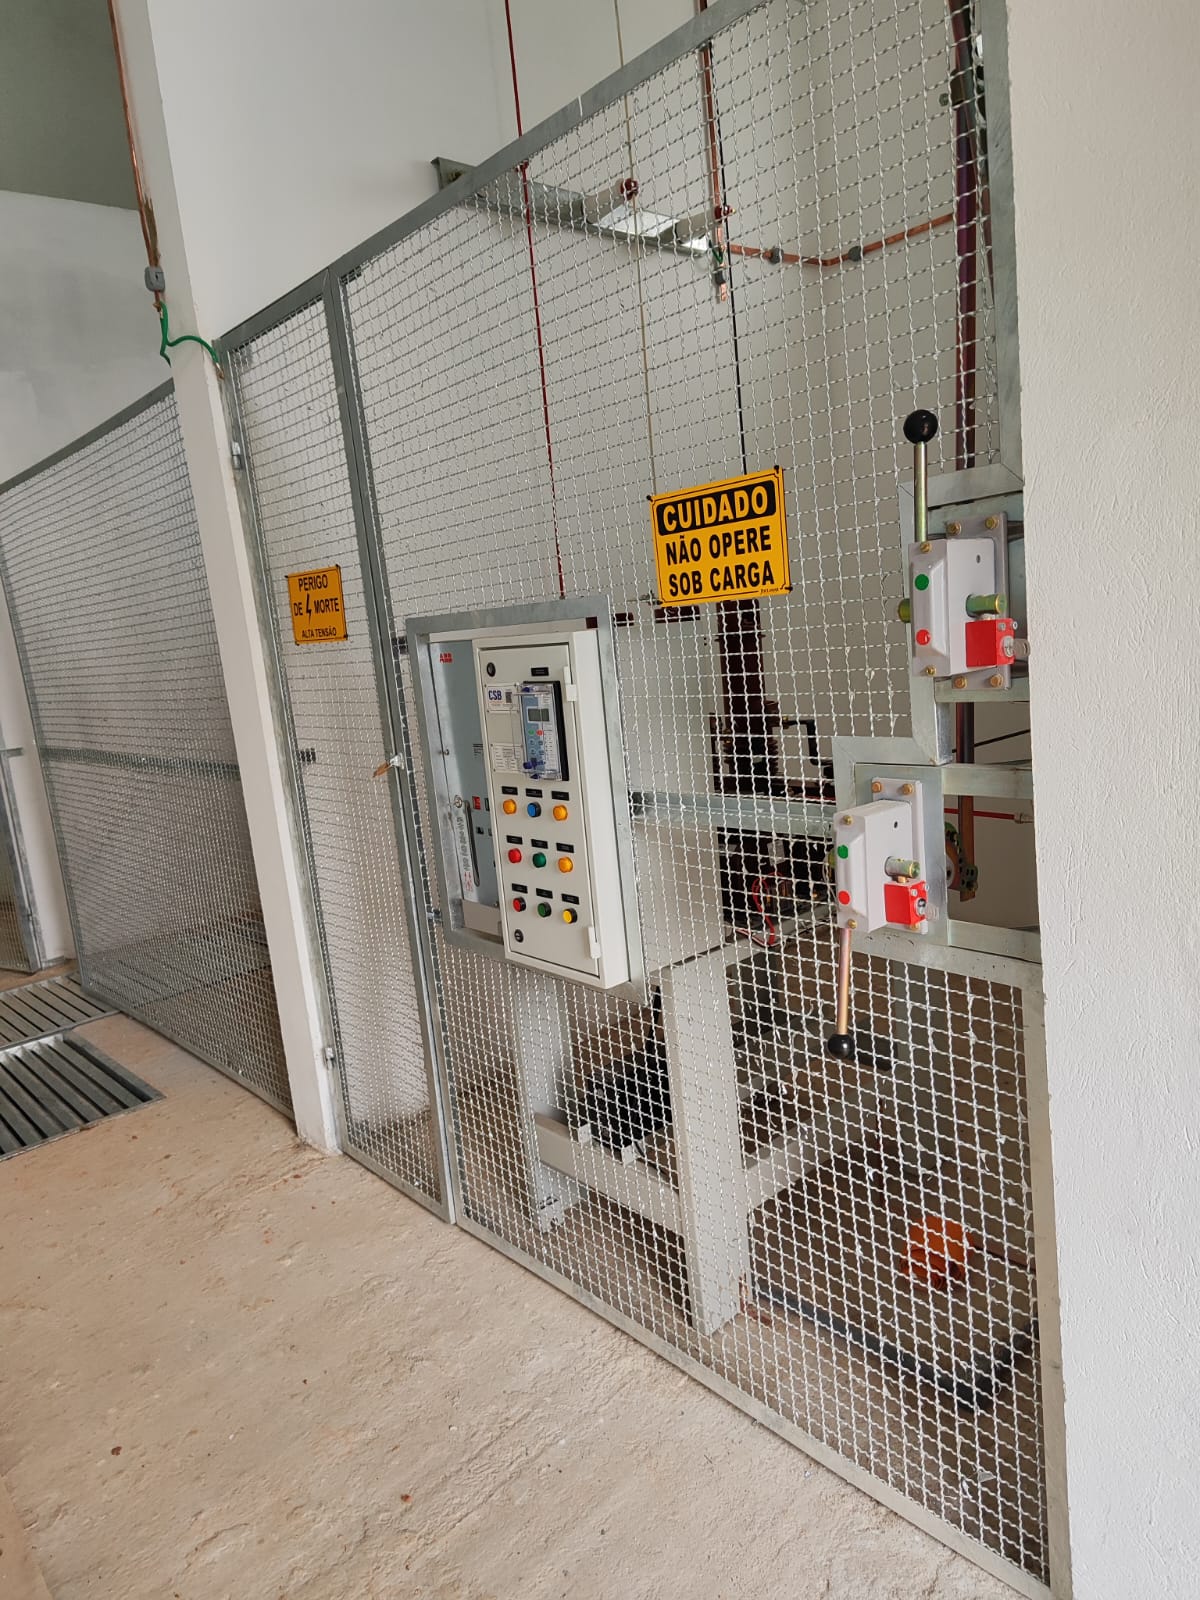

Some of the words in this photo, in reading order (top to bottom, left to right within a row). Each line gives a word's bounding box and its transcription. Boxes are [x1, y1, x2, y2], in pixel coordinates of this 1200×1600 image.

[663, 486, 768, 532] CUIDADO
[666, 535, 702, 566] NÃO
[709, 525, 772, 559] OPERE
[298, 574, 329, 592] PERIGO
[669, 570, 703, 597] SOB
[710, 560, 775, 592] CARGA
[293, 602, 303, 617] DE
[313, 598, 340, 614] MORTE
[302, 629, 315, 639] ALTA
[315, 625, 337, 638] TENSÃO
[439, 653, 453, 663] ABB
[488, 690, 502, 701] CSB
